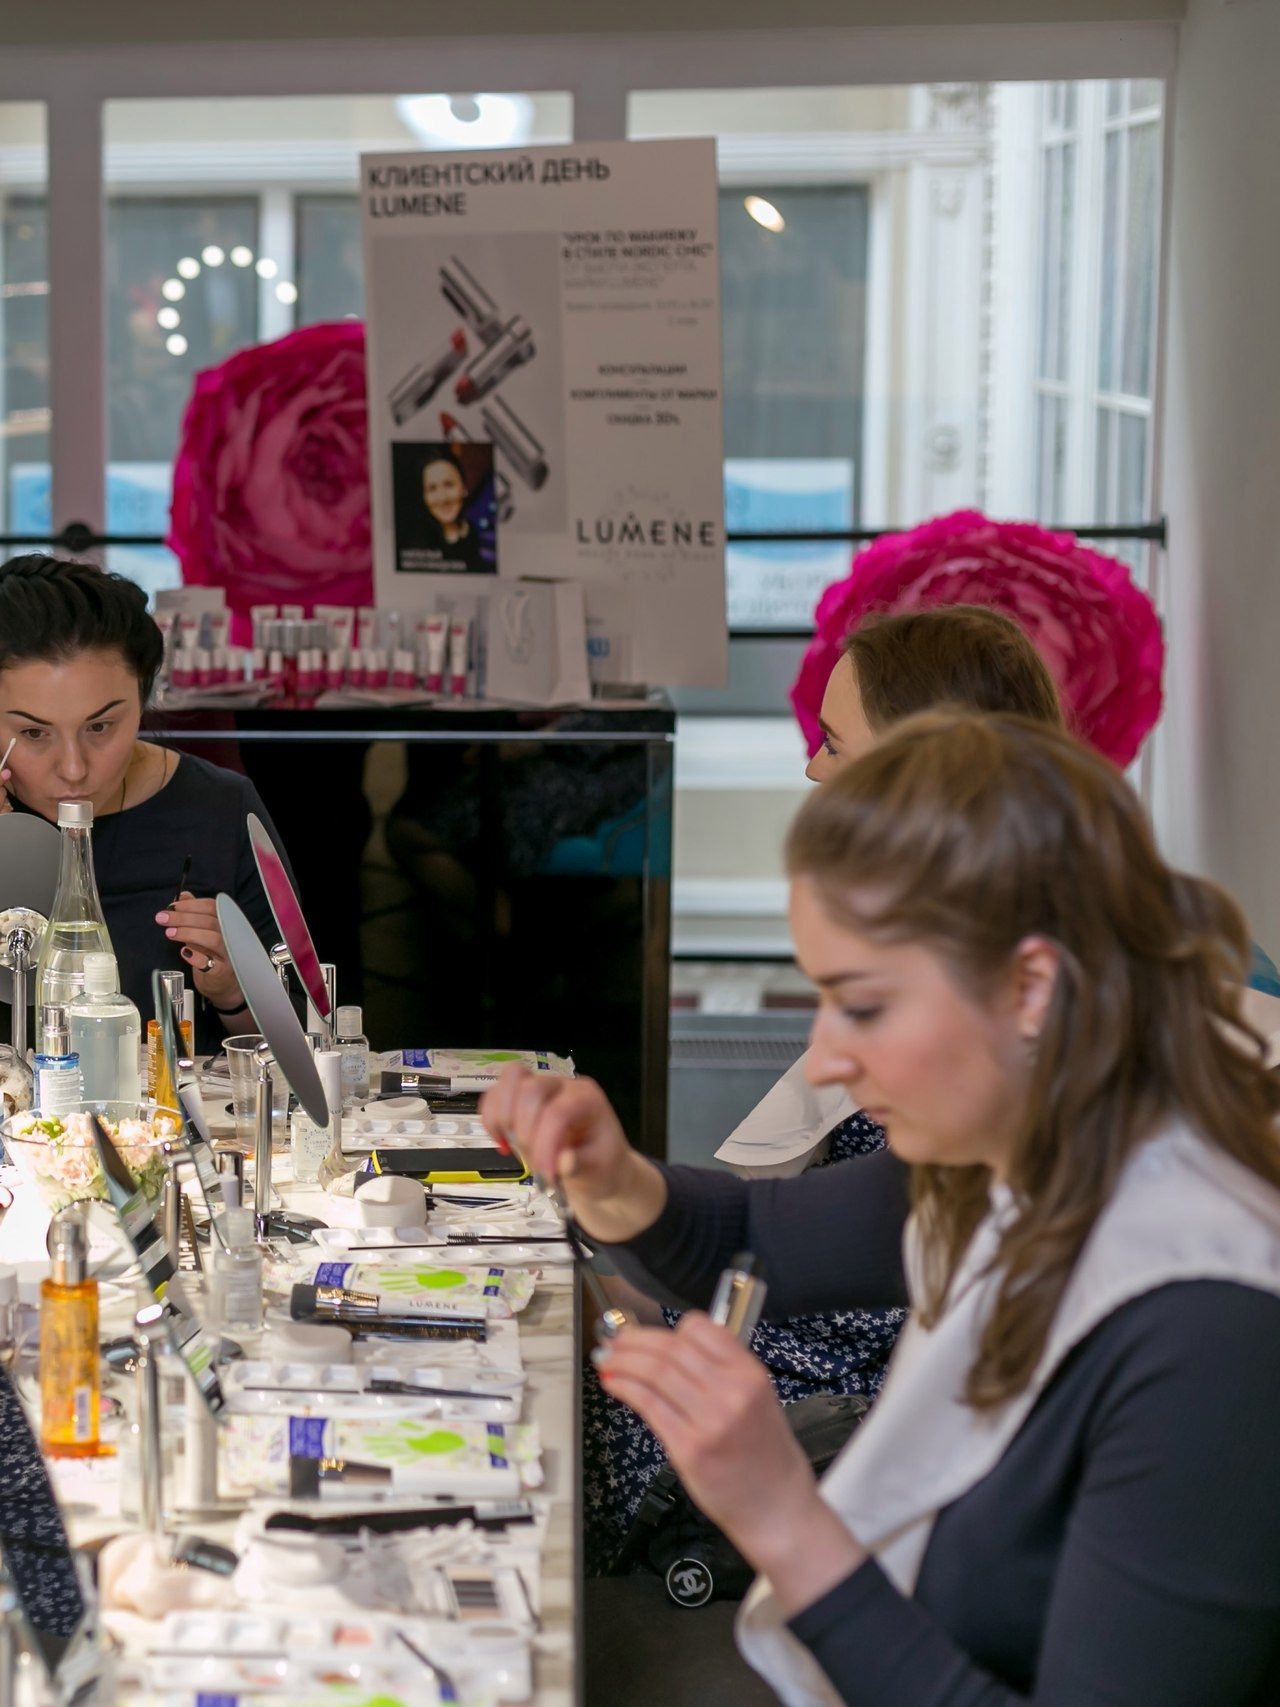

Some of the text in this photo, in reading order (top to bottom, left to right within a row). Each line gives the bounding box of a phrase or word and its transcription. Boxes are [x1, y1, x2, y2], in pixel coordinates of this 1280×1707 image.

[369, 156, 610, 188] КЛИЕНТСКИЙ ДЕНЬ
[370, 192, 468, 218] LUMENE
[576, 517, 716, 547] LUMENE
[408, 1299, 458, 1311] LUMENE
